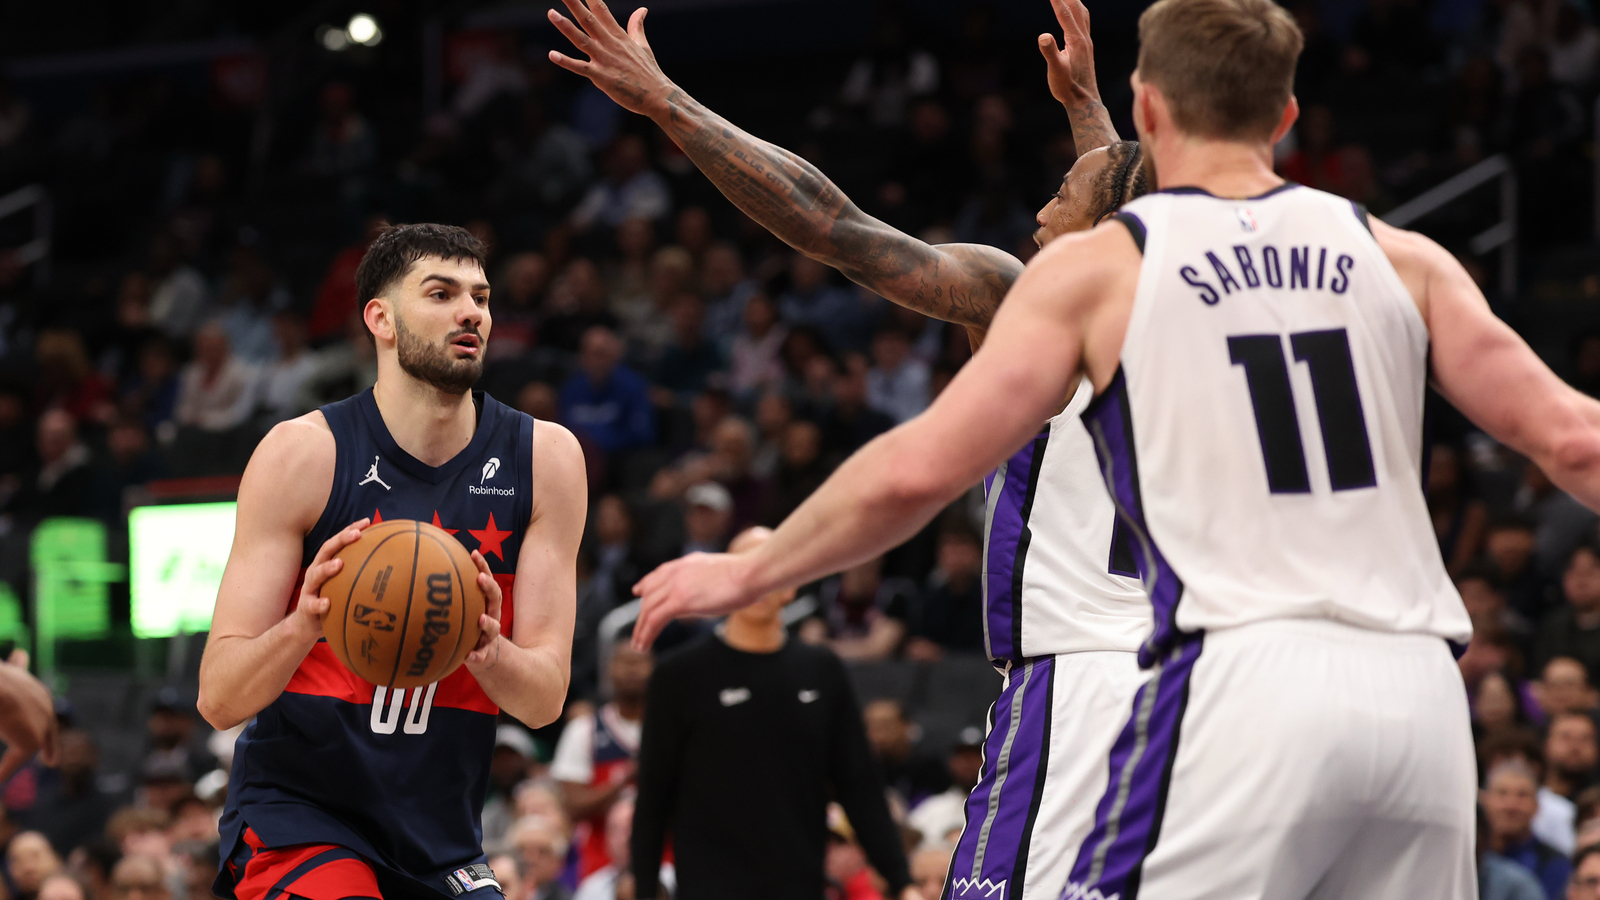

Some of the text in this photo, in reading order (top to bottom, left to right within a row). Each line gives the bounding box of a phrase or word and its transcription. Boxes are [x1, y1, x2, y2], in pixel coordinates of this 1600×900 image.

[733, 149, 791, 192] BLUE CITY
[1179, 245, 1354, 306] SABONIS
[1226, 327, 1378, 495] 11
[468, 485, 515, 496] Robinhood
[406, 570, 453, 678] Wilson
